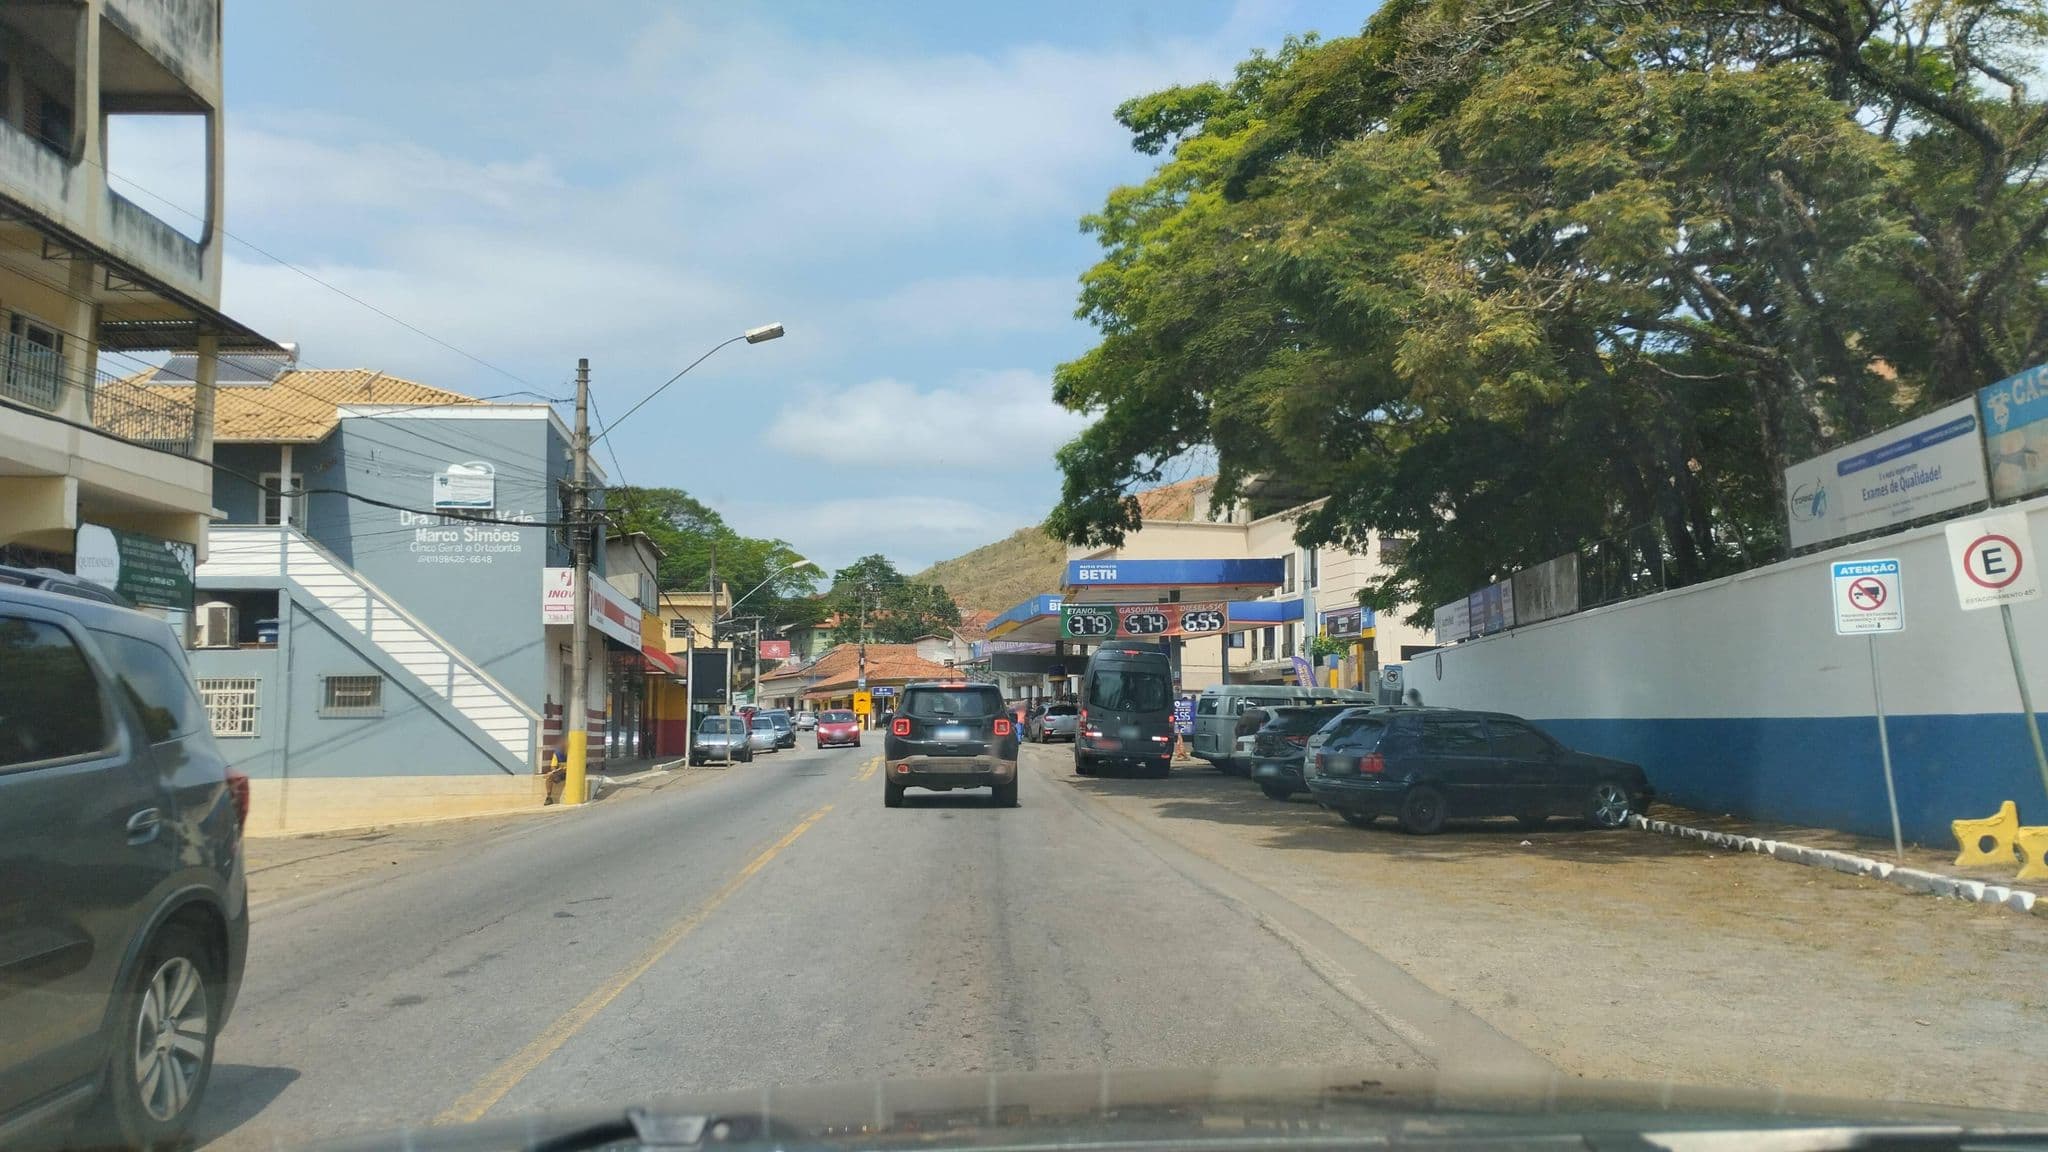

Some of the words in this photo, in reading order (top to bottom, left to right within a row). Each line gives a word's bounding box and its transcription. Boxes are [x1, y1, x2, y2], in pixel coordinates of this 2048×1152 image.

[1862, 486, 1888, 501] Exames
[1889, 482, 1899, 493] de
[1900, 464, 1942, 491] Qualidade!
[400, 510, 434, 526] Dra.
[415, 528, 459, 542] Marco
[463, 527, 520, 542] Simões
[438, 543, 463, 552] Geral
[474, 542, 521, 552] Ortodontia
[1982, 547, 2006, 575] E
[1079, 569, 1117, 580] BETH
[1840, 563, 1896, 575] ATENÇÃO
[1965, 590, 2024, 604] ESTACIONAMENTO
[1067, 607, 1097, 615] ETANOL
[1119, 606, 1159, 614] GASOLINA
[1073, 615, 1107, 634] 3.79
[1130, 615, 1163, 633] 5.74
[1185, 612, 1221, 632] 6.55
